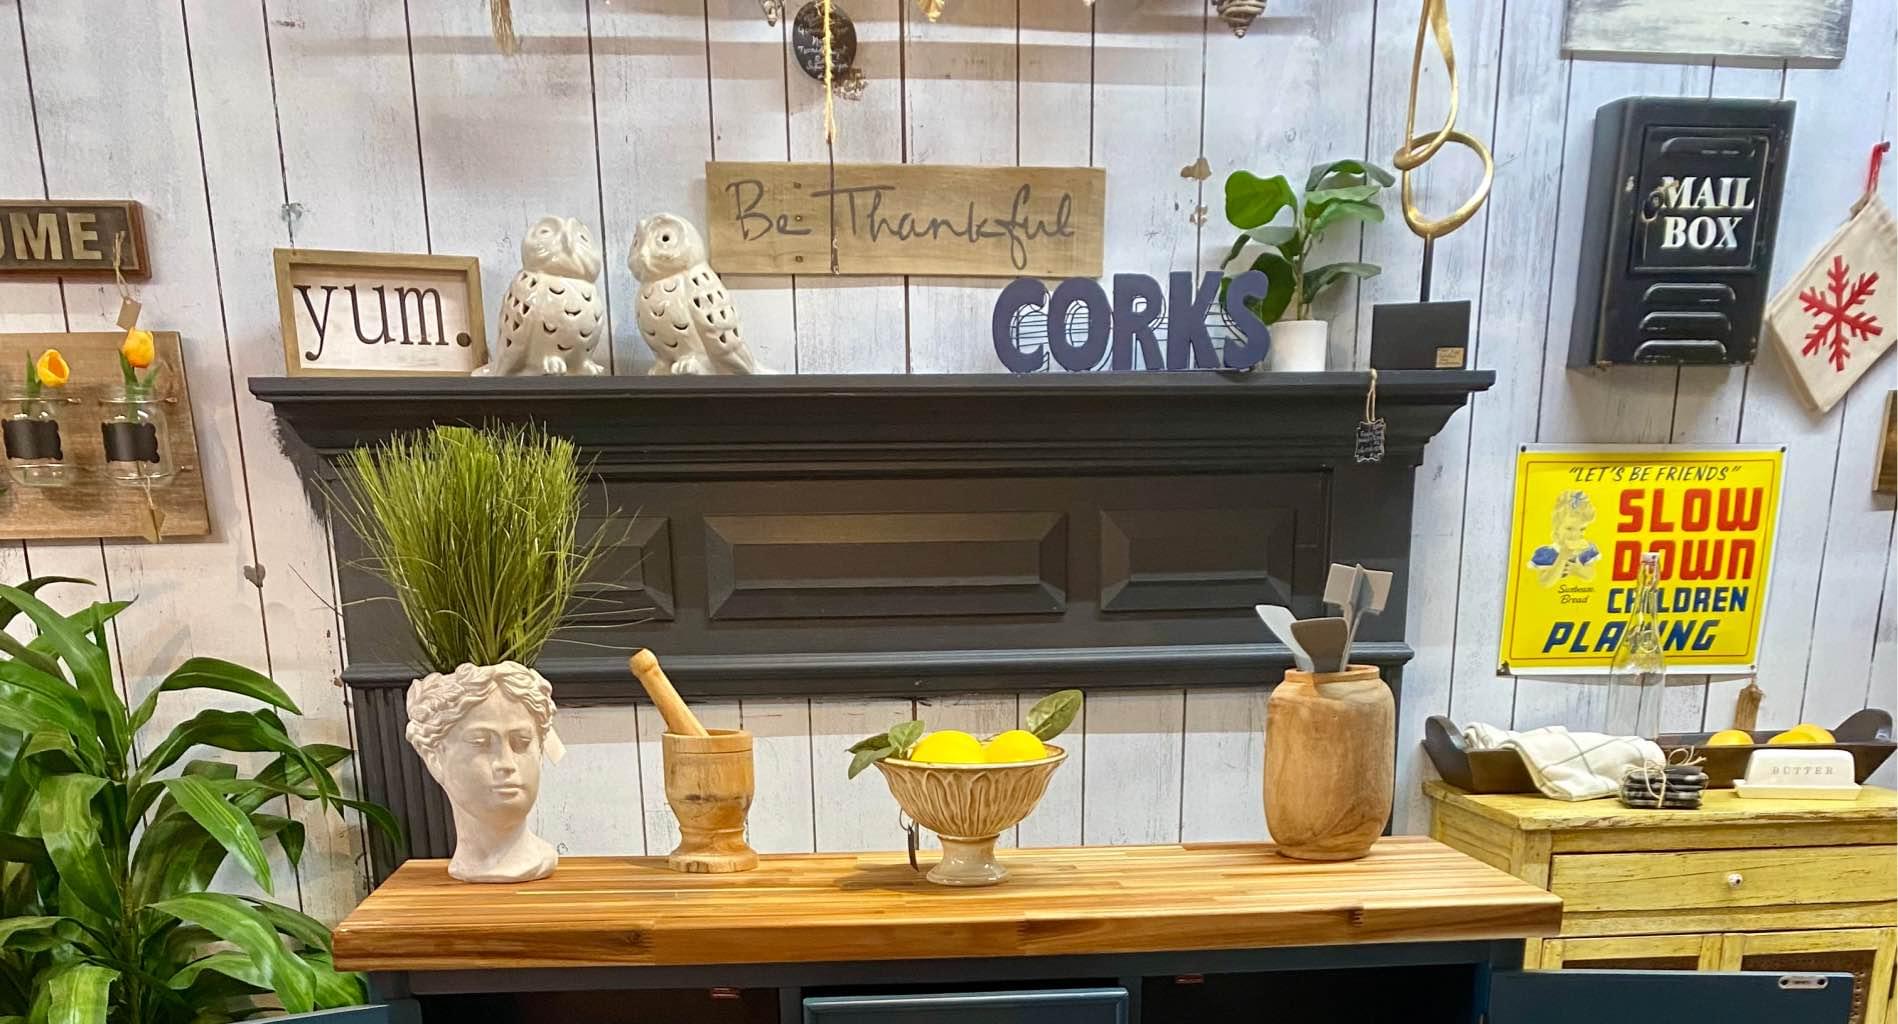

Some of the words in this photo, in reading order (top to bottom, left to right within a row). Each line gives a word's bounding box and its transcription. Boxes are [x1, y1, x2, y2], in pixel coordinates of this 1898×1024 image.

[1660, 176, 1755, 209] MAIL
[0, 212, 102, 260] ME
[726, 179, 811, 241] Be
[811, 184, 1074, 270] Thankful
[1660, 216, 1743, 249] BOX
[293, 284, 473, 361] yum.
[992, 270, 1271, 373] CORKS
[1569, 466, 1624, 482] "LET'S
[1629, 466, 1655, 481] BE
[1655, 465, 1742, 481] FRIENDS"
[1617, 487, 1764, 533] SLOW
[1612, 539, 1756, 581] DOWN
[1560, 594, 1590, 604] Bread
[1607, 586, 1749, 613] CHLDREN
[1542, 620, 1721, 653] PLANG
[1772, 766, 1834, 775] BUTTER
